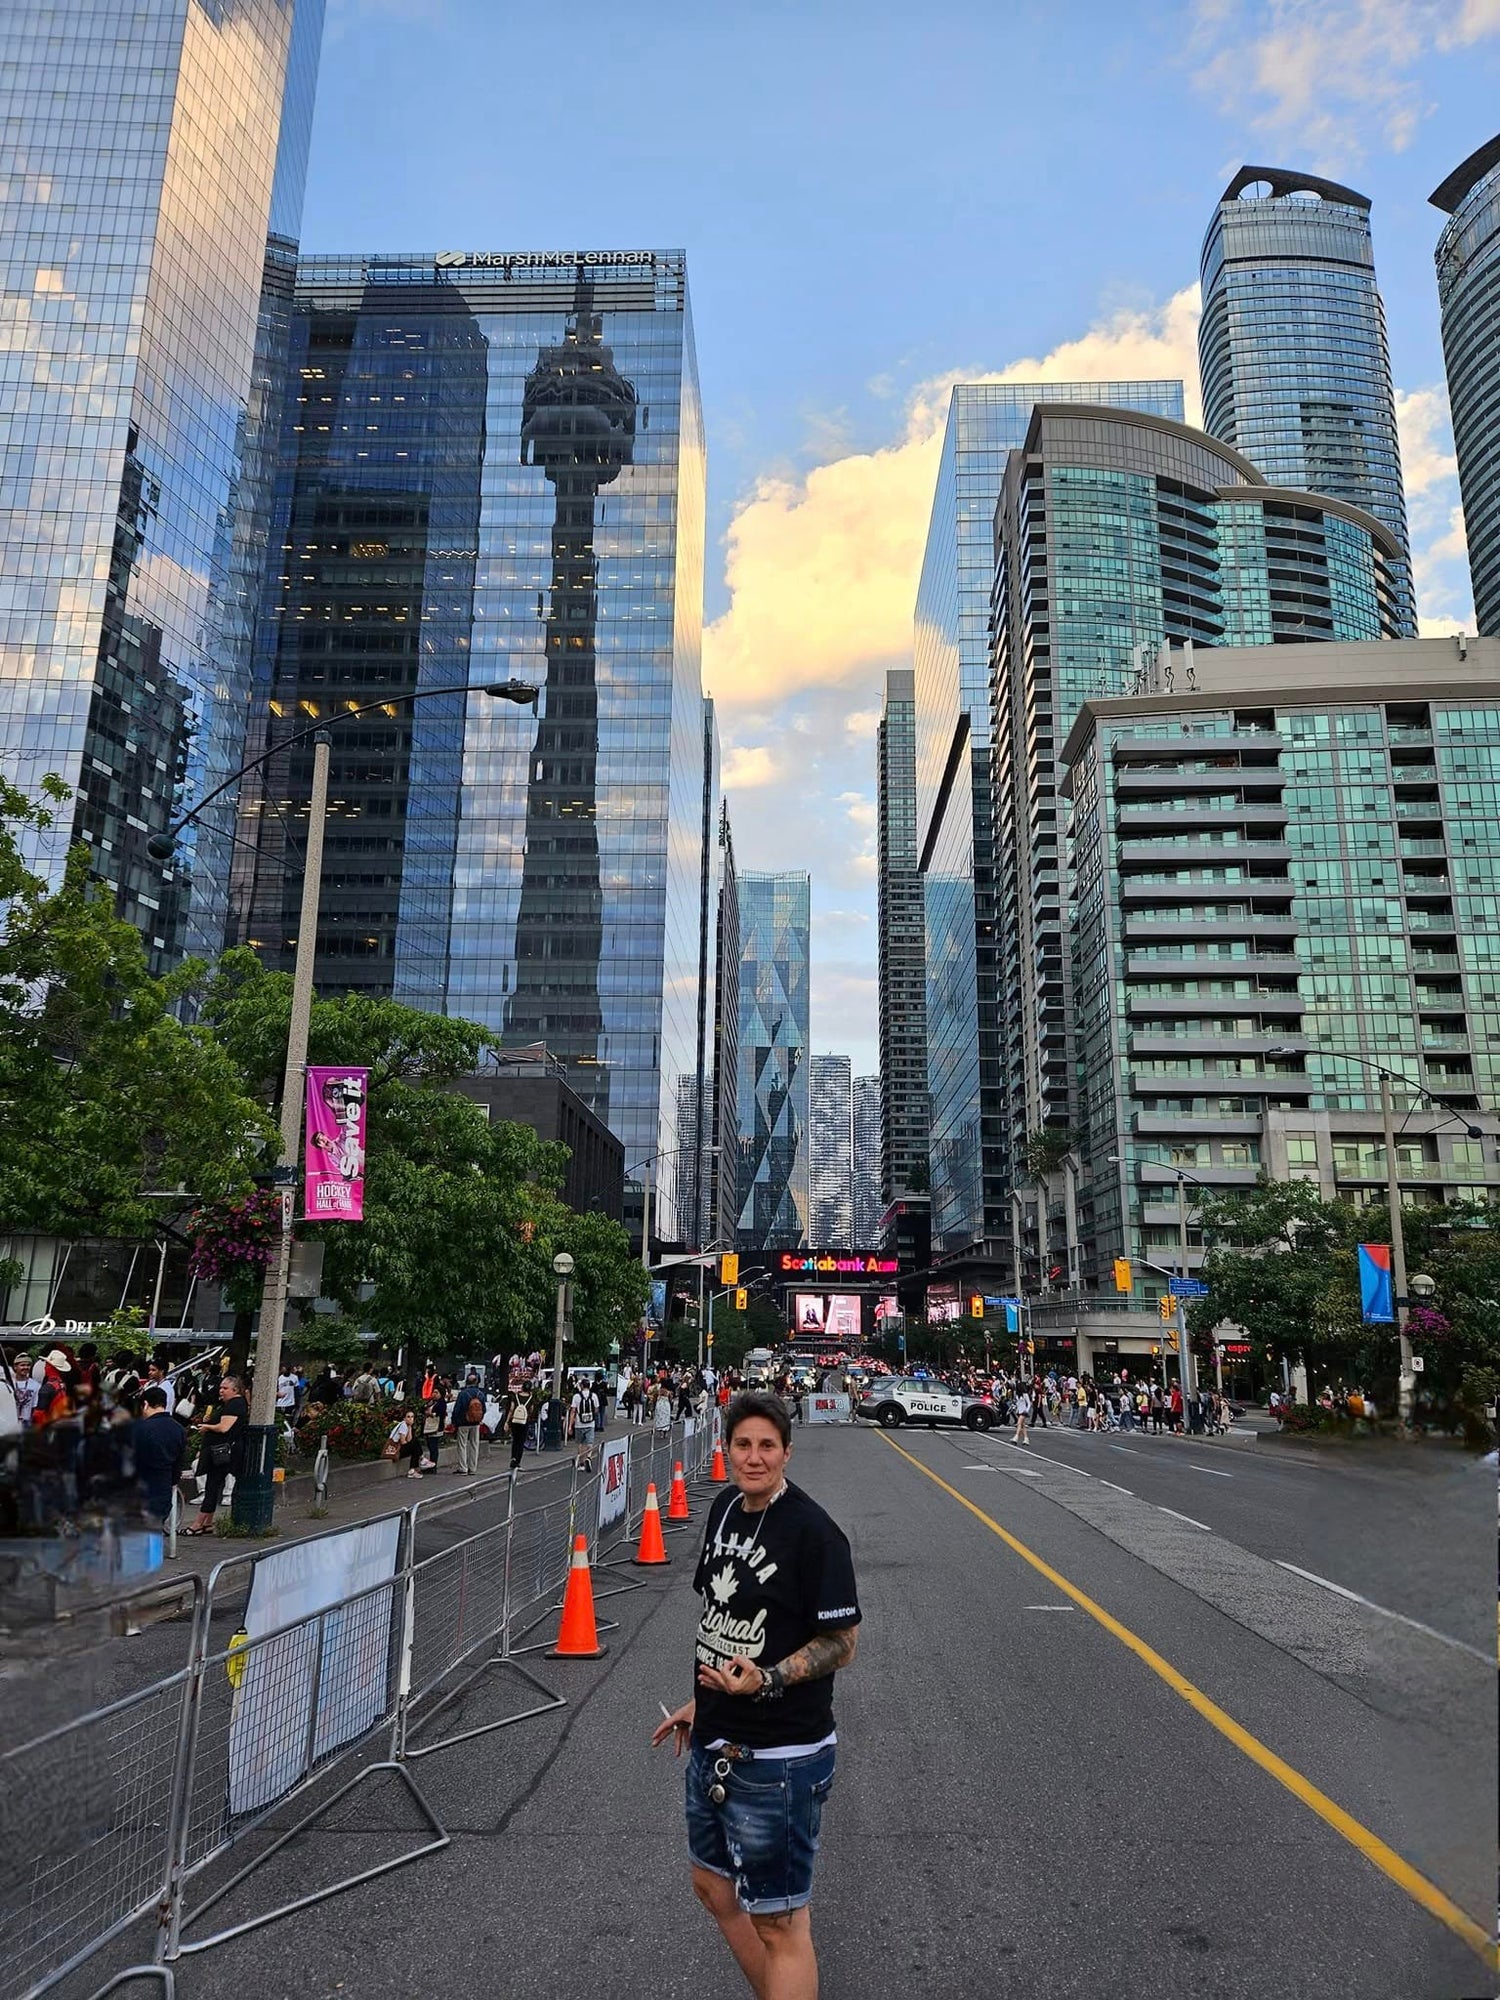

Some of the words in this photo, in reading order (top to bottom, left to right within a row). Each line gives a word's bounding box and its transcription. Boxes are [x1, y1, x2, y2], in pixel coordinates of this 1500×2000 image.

[472, 249, 653, 266] MarshMcLennan
[316, 1184, 352, 1198] HOCKEY
[316, 1199, 332, 1208] HALL
[781, 1254, 865, 1272] Scotiabank
[910, 1402, 947, 1413] POLICE
[696, 1644, 716, 1667] SINCE
